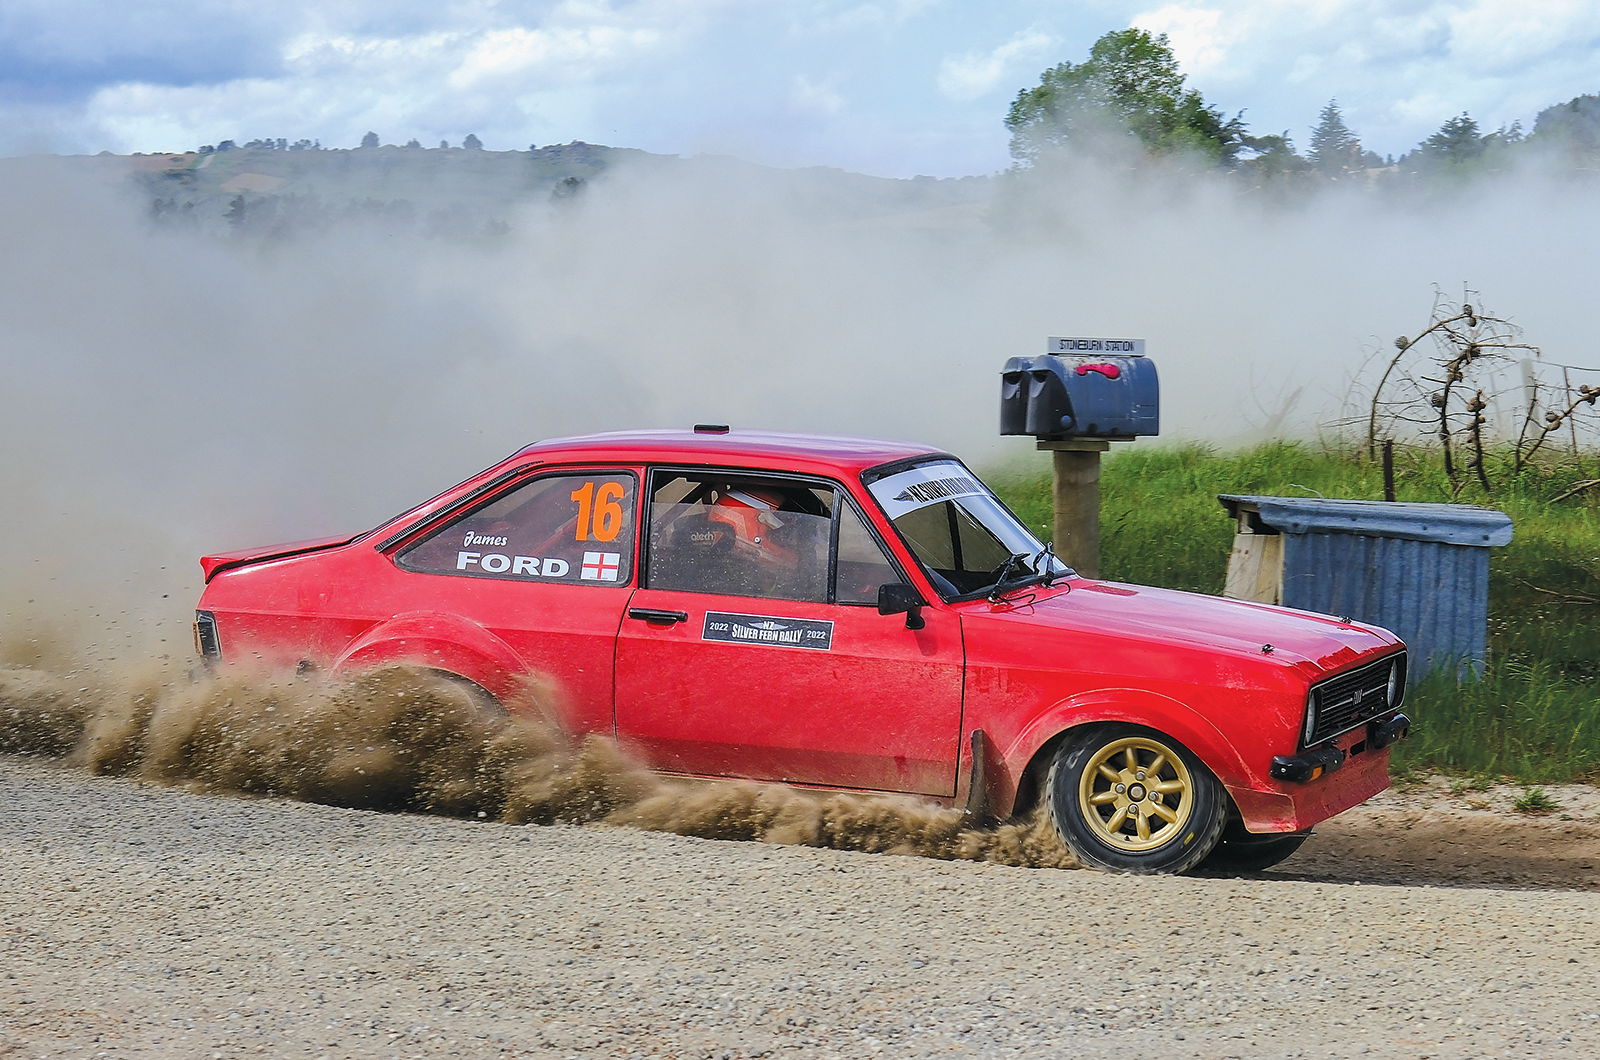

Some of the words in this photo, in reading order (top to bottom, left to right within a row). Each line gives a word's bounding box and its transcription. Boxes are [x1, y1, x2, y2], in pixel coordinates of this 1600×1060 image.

[1059, 339, 1103, 351] STONEBURN
[1105, 340, 1135, 352] STATION
[571, 481, 626, 542] 16
[463, 530, 508, 547] James
[456, 550, 570, 577] FORD
[709, 622, 729, 631] 2022
[732, 624, 759, 639] SILVER
[759, 629, 778, 641] FERN
[779, 629, 803, 643] RALLY
[806, 630, 826, 640] 2022
[763, 620, 775, 630] NZ
